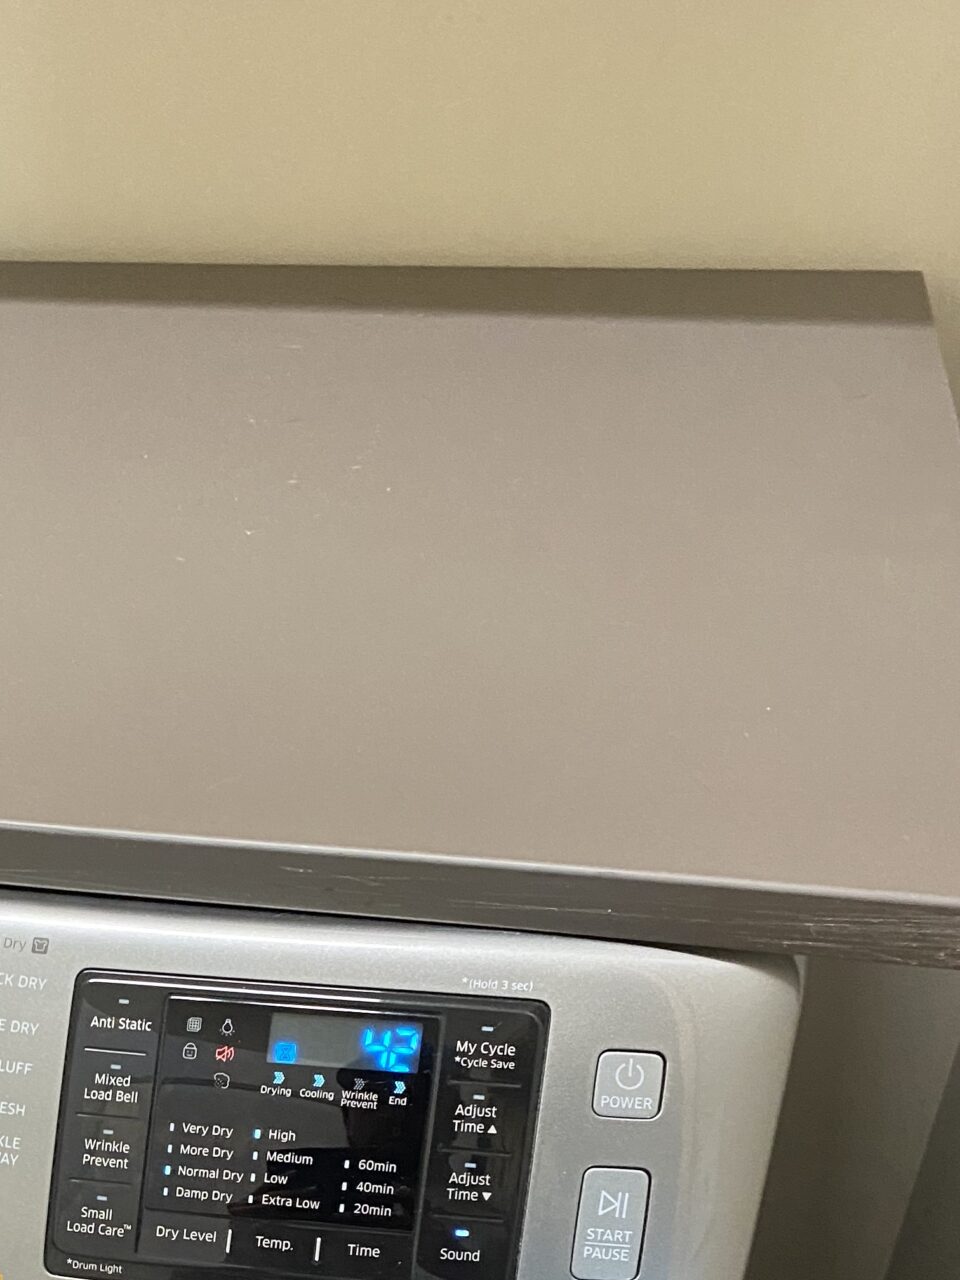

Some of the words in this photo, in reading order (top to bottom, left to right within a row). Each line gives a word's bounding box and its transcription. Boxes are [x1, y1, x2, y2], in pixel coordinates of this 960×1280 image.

[3, 937, 27, 953] Dry
[17, 975, 48, 991] DRY
[501, 980, 509, 990] 3
[511, 981, 534, 992] sec)
[10, 1019, 40, 1036] DRY
[90, 1015, 115, 1029] Anti
[118, 1017, 152, 1031] Static
[364, 1026, 419, 1073] 42
[455, 1040, 478, 1055] My
[480, 1041, 516, 1056] Cycle
[490, 1059, 516, 1070] Save
[94, 1072, 131, 1087] Mixed
[83, 1087, 113, 1101] Load
[115, 1090, 139, 1104] Bell
[260, 1085, 292, 1098] Drying
[299, 1088, 335, 1101] Cooling
[341, 1090, 378, 1102] Wrinkle
[340, 1099, 378, 1110] Prevent
[388, 1095, 408, 1106] End
[600, 1095, 653, 1110] POWER
[455, 1103, 498, 1119] Adjust
[182, 1122, 210, 1138] Very
[212, 1125, 234, 1139] Dry
[452, 1119, 486, 1134] Time
[268, 1128, 297, 1143] High
[84, 1138, 131, 1154] Wrinkle
[179, 1144, 210, 1157] More
[212, 1147, 235, 1161] Dry
[82, 1154, 129, 1170] Prevent
[266, 1151, 314, 1166] Medium
[358, 1159, 398, 1174] 60min
[177, 1165, 220, 1180] Normal
[222, 1169, 245, 1184] Dry
[263, 1172, 289, 1185] Low
[448, 1171, 492, 1187] Adjust
[175, 1186, 209, 1202] Damp
[211, 1190, 234, 1205] Dry
[355, 1181, 395, 1196] 40min
[446, 1187, 480, 1202] Time
[261, 1194, 293, 1208] Extra
[295, 1198, 321, 1211] Low
[80, 1206, 113, 1221] Small
[353, 1203, 393, 1218] 20min
[66, 1220, 95, 1234] Load
[155, 1225, 180, 1242] Dry
[182, 1228, 218, 1243] Level
[586, 1227, 634, 1243] START
[255, 1235, 294, 1251] Temp.
[347, 1243, 381, 1258] Time
[439, 1247, 481, 1263] Sound
[583, 1246, 630, 1262] PAUSE
[99, 1263, 123, 1275] Light
